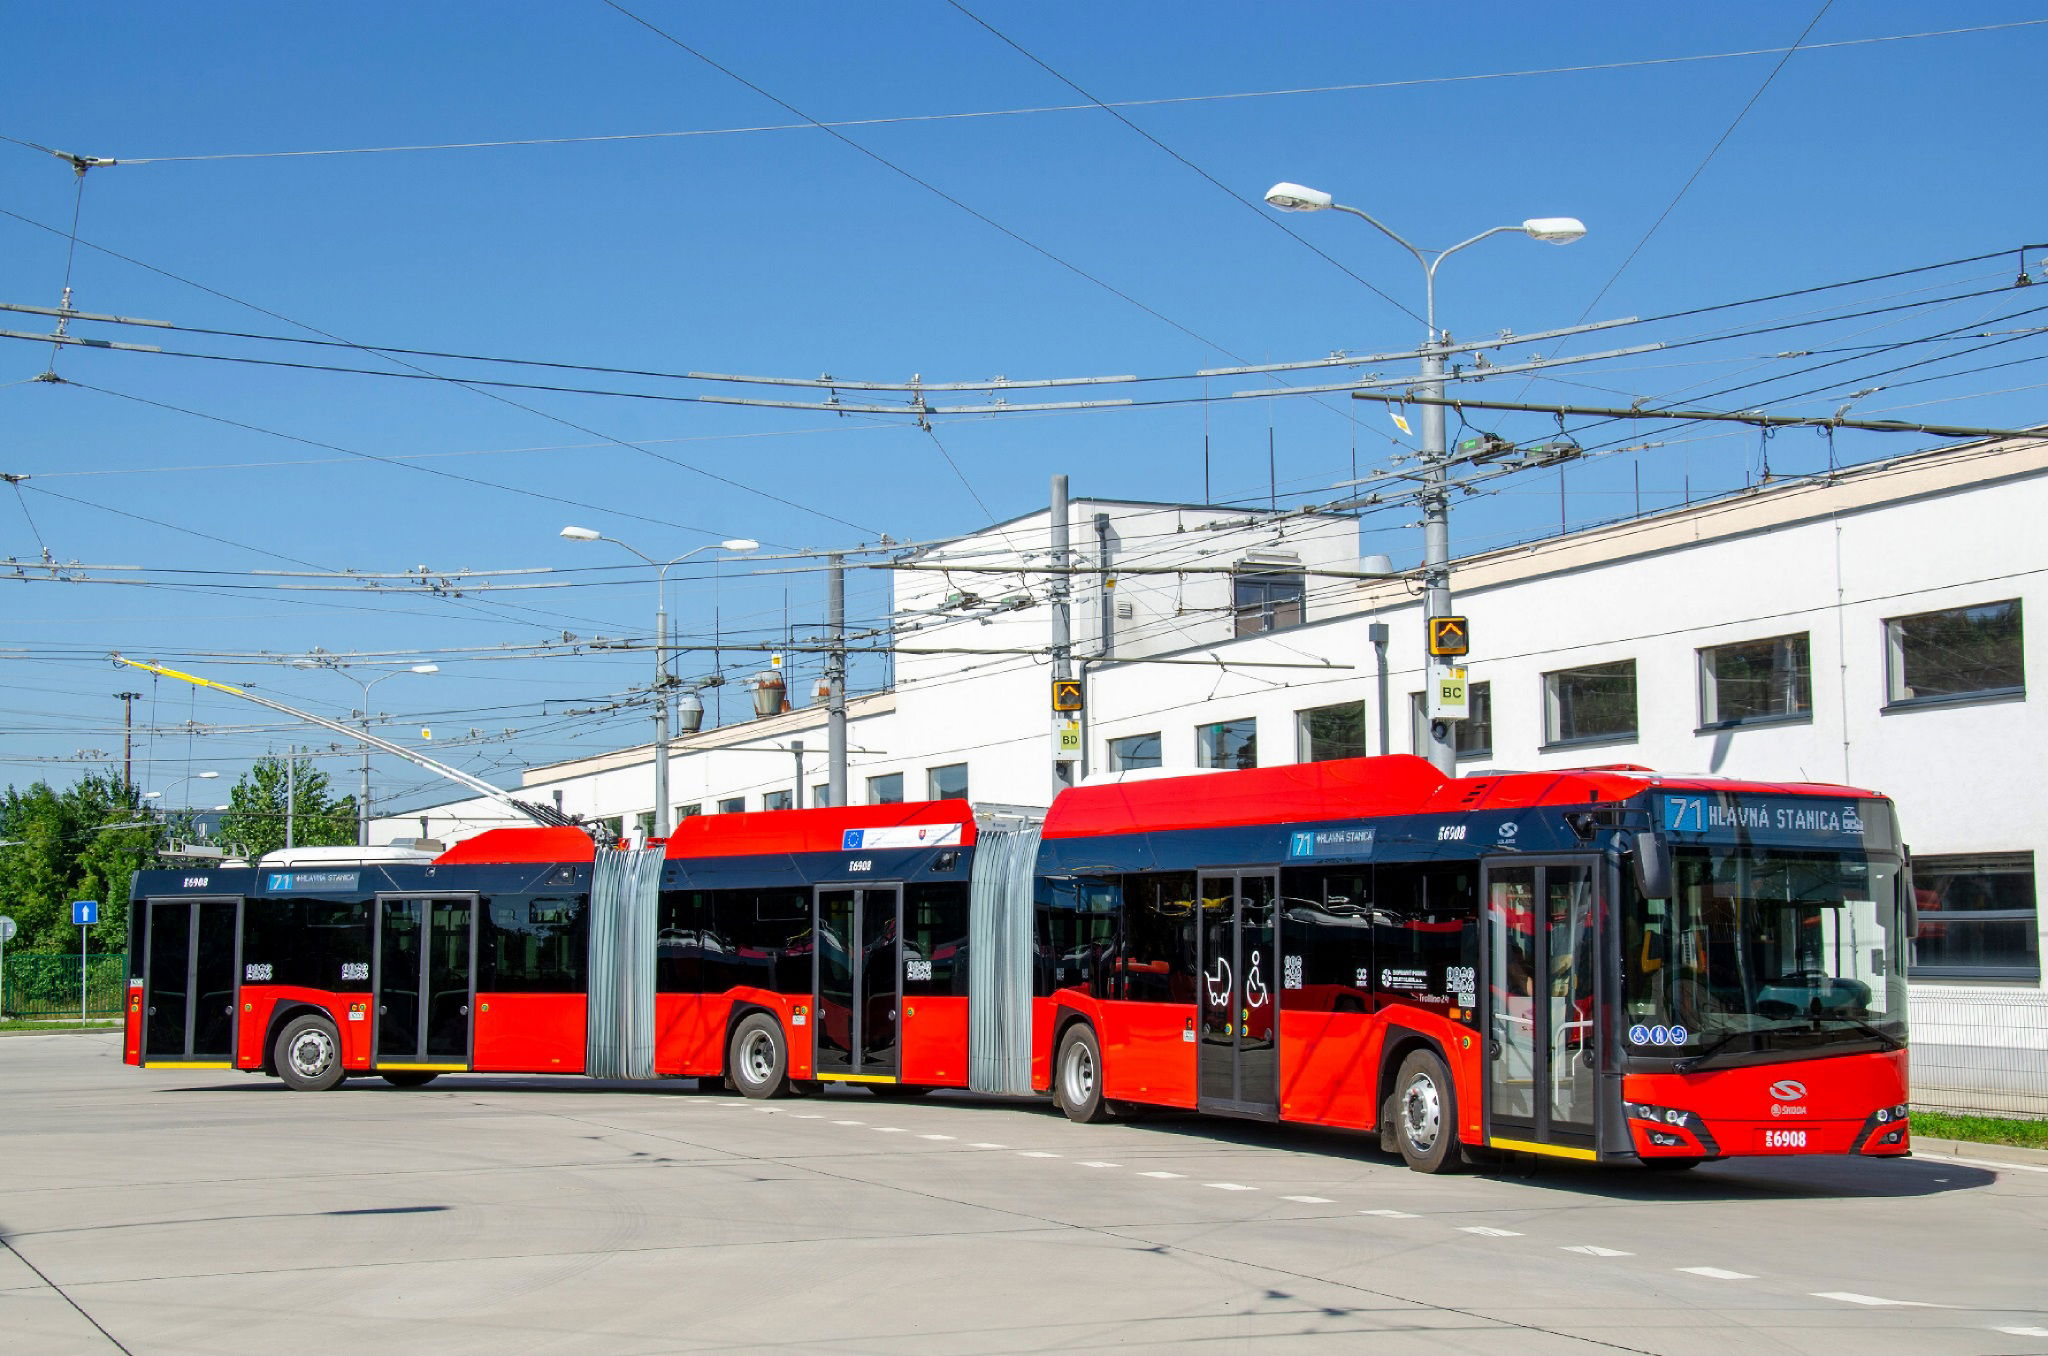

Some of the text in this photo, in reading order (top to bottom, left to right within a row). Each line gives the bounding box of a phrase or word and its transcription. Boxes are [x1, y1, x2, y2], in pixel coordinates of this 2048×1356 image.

[1443, 687, 1462, 698] BC
[1062, 735, 1078, 745] BD
[1670, 798, 1840, 831] 71 HLAVNÁ STANICA
[1296, 833, 1312, 856] 71
[273, 874, 290, 890] 71
[1773, 1130, 1807, 1148] 6908
